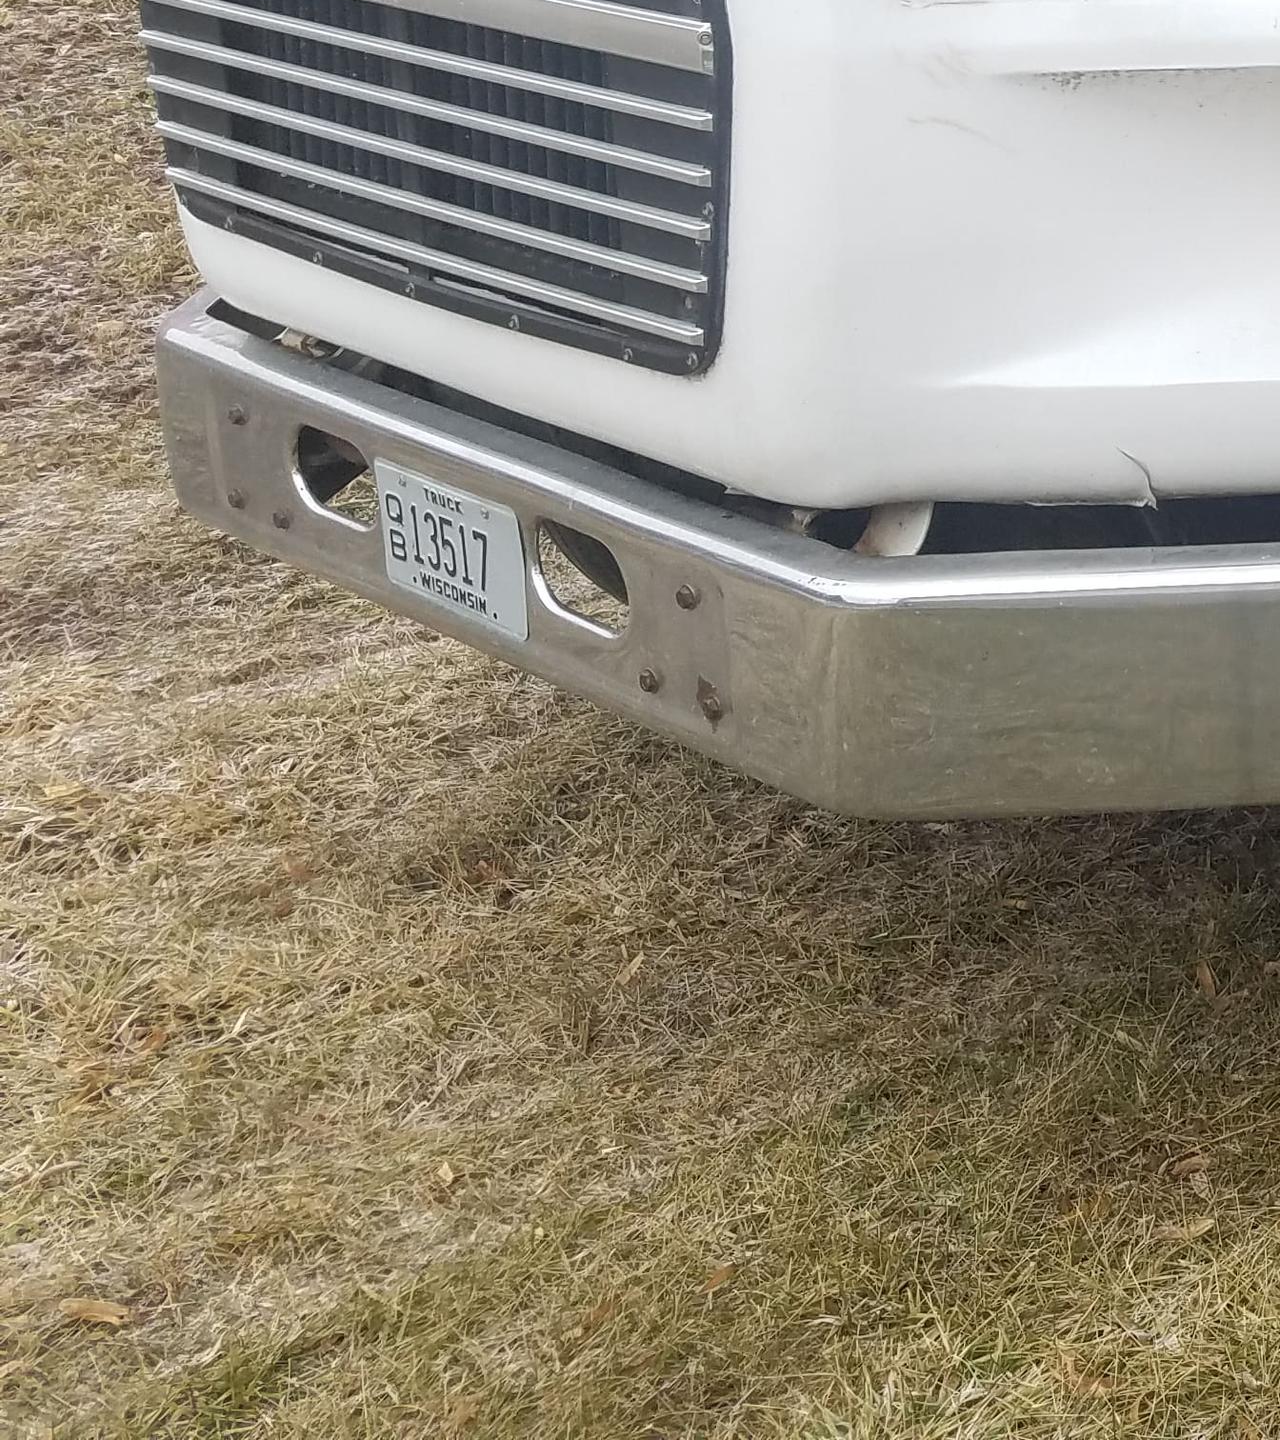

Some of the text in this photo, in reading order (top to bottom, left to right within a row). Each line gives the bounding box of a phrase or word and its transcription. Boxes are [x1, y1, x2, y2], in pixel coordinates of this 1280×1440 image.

[422, 486, 464, 516] TRUCK
[409, 504, 489, 593] 13517
[419, 570, 488, 616] WISCONSIN
